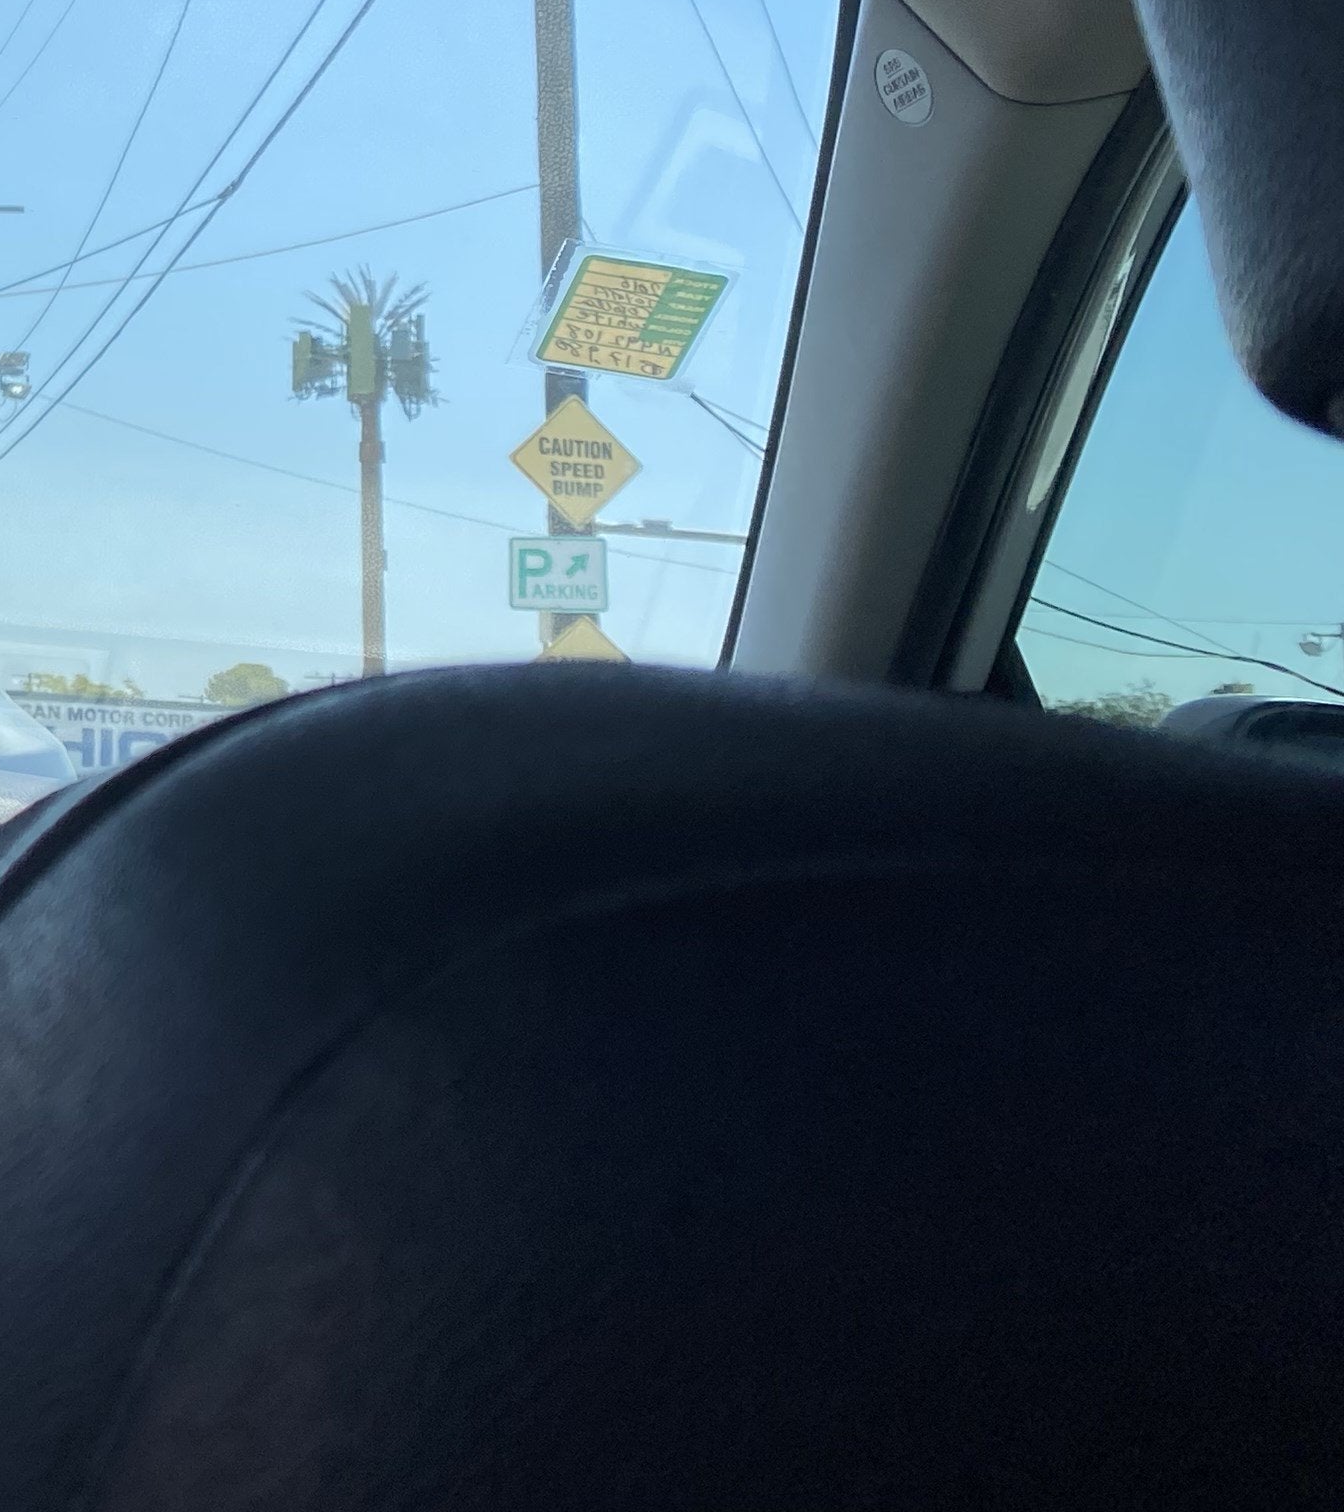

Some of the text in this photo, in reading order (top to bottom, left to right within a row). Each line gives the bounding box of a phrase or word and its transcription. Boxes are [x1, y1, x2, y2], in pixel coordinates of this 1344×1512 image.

[538, 437, 613, 459] CAUTION
[550, 461, 605, 480] SPEED
[552, 479, 604, 500] BUMP
[67, 706, 134, 726] MOTOR
